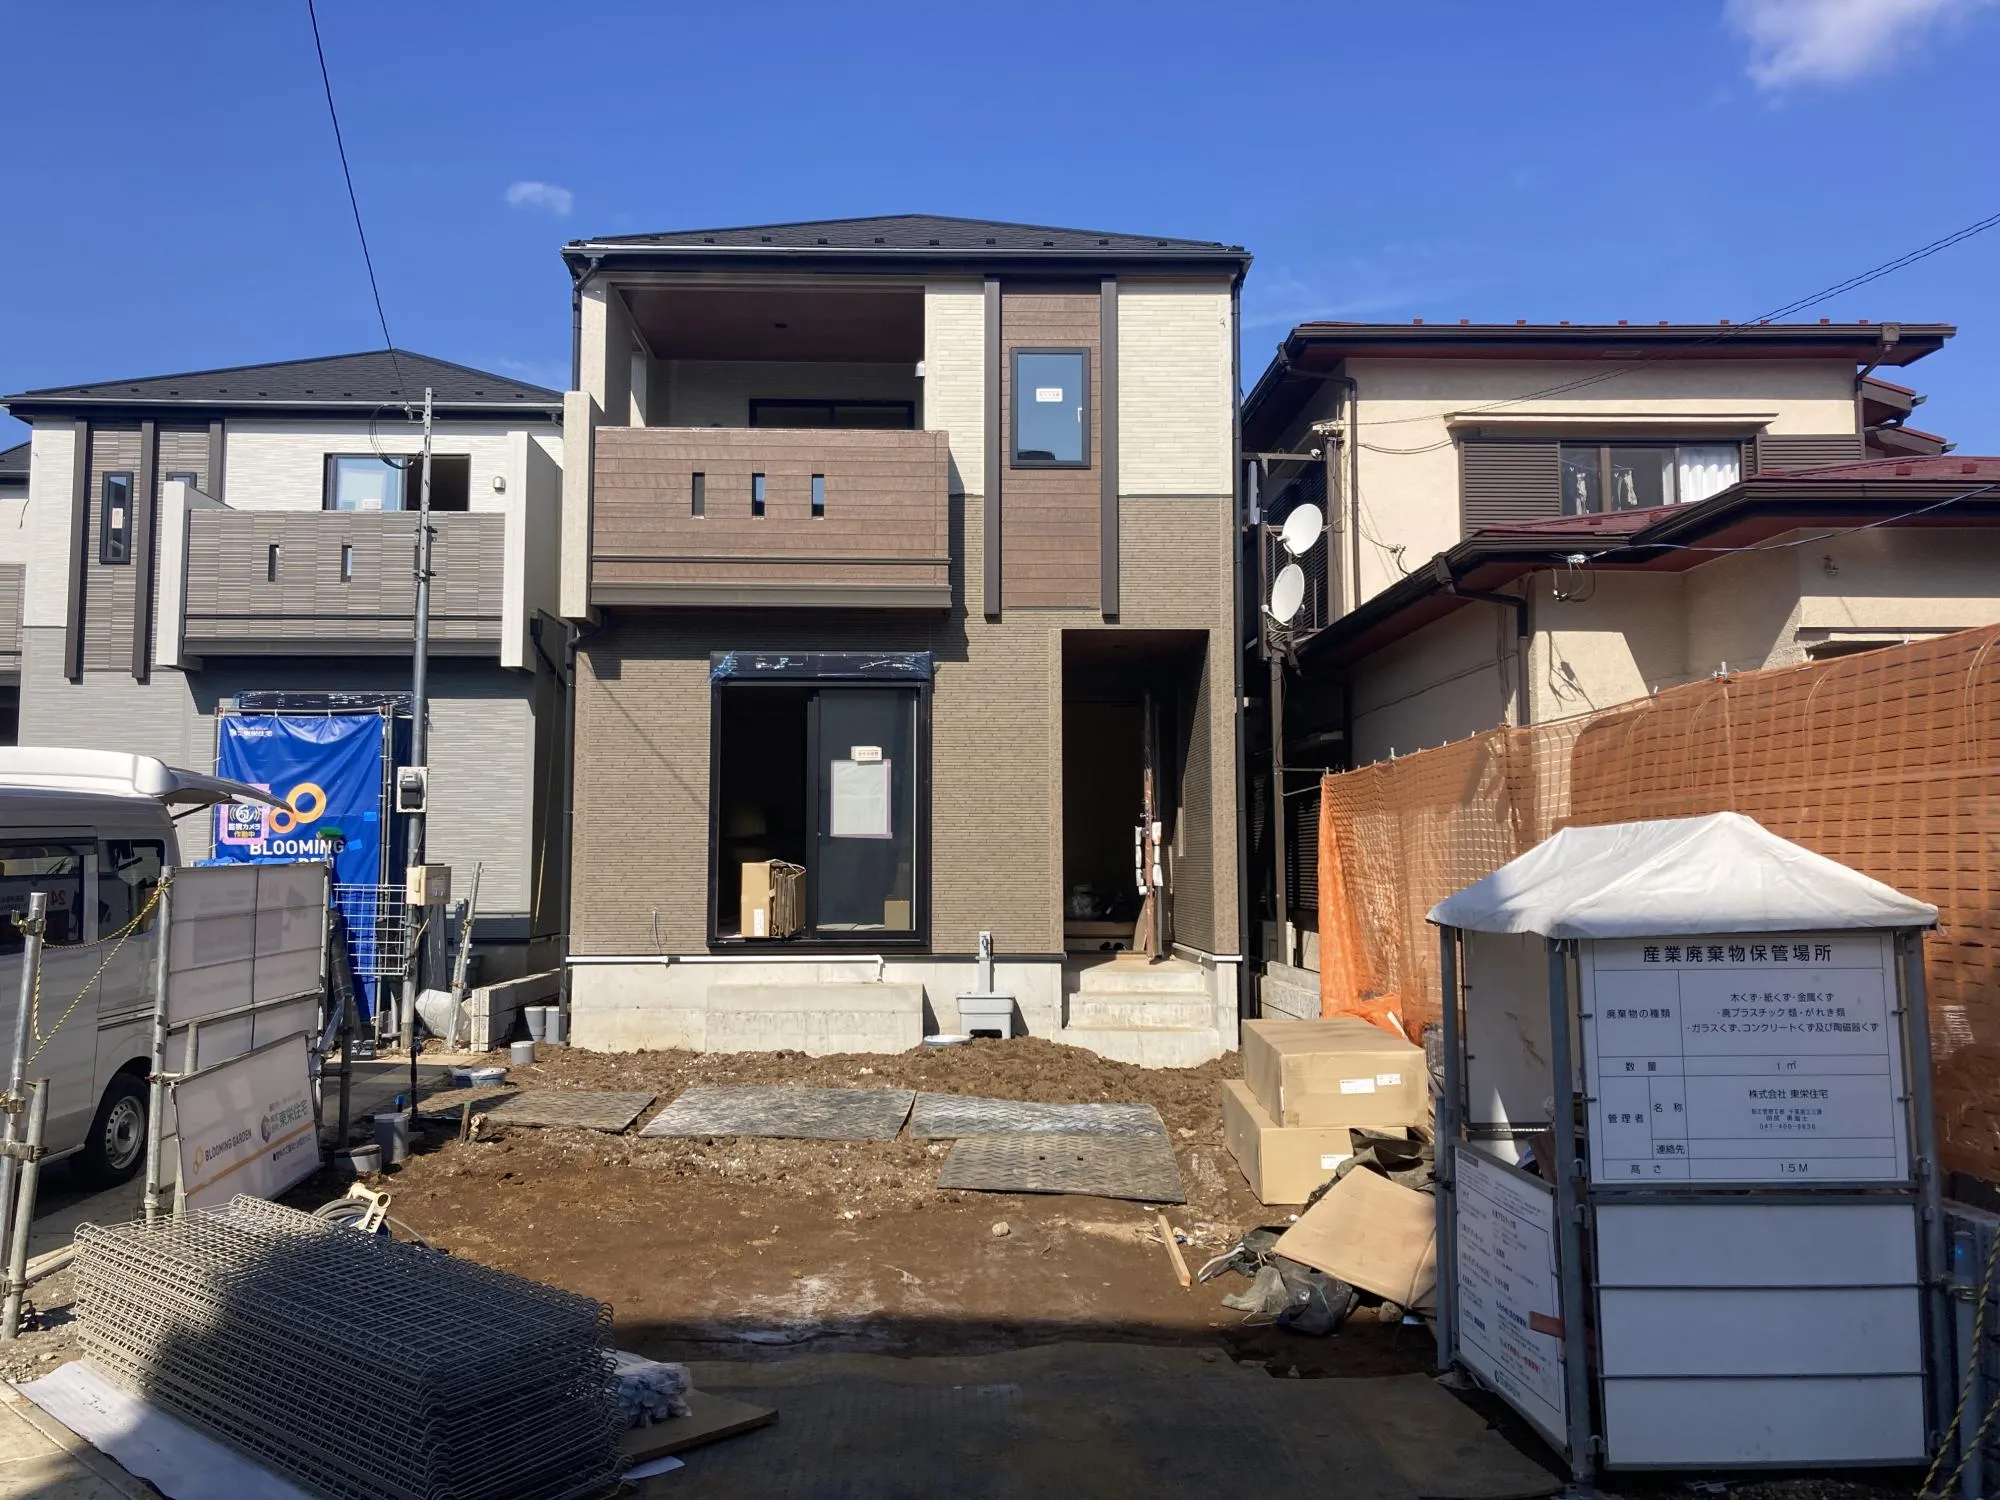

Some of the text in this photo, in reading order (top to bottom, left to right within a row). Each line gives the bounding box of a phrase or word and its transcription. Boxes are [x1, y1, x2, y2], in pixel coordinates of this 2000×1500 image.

[249, 839, 345, 856] BLOOMING
[1643, 944, 1832, 963] 産業廃棄物保管場所
[1606, 1008, 1671, 1019] 廃棄物の種類
[1749, 1088, 1829, 1099] 株式会社 東栄住宅
[1607, 1113, 1645, 1124] 管理者
[1655, 1144, 1686, 1155] 連絡先
